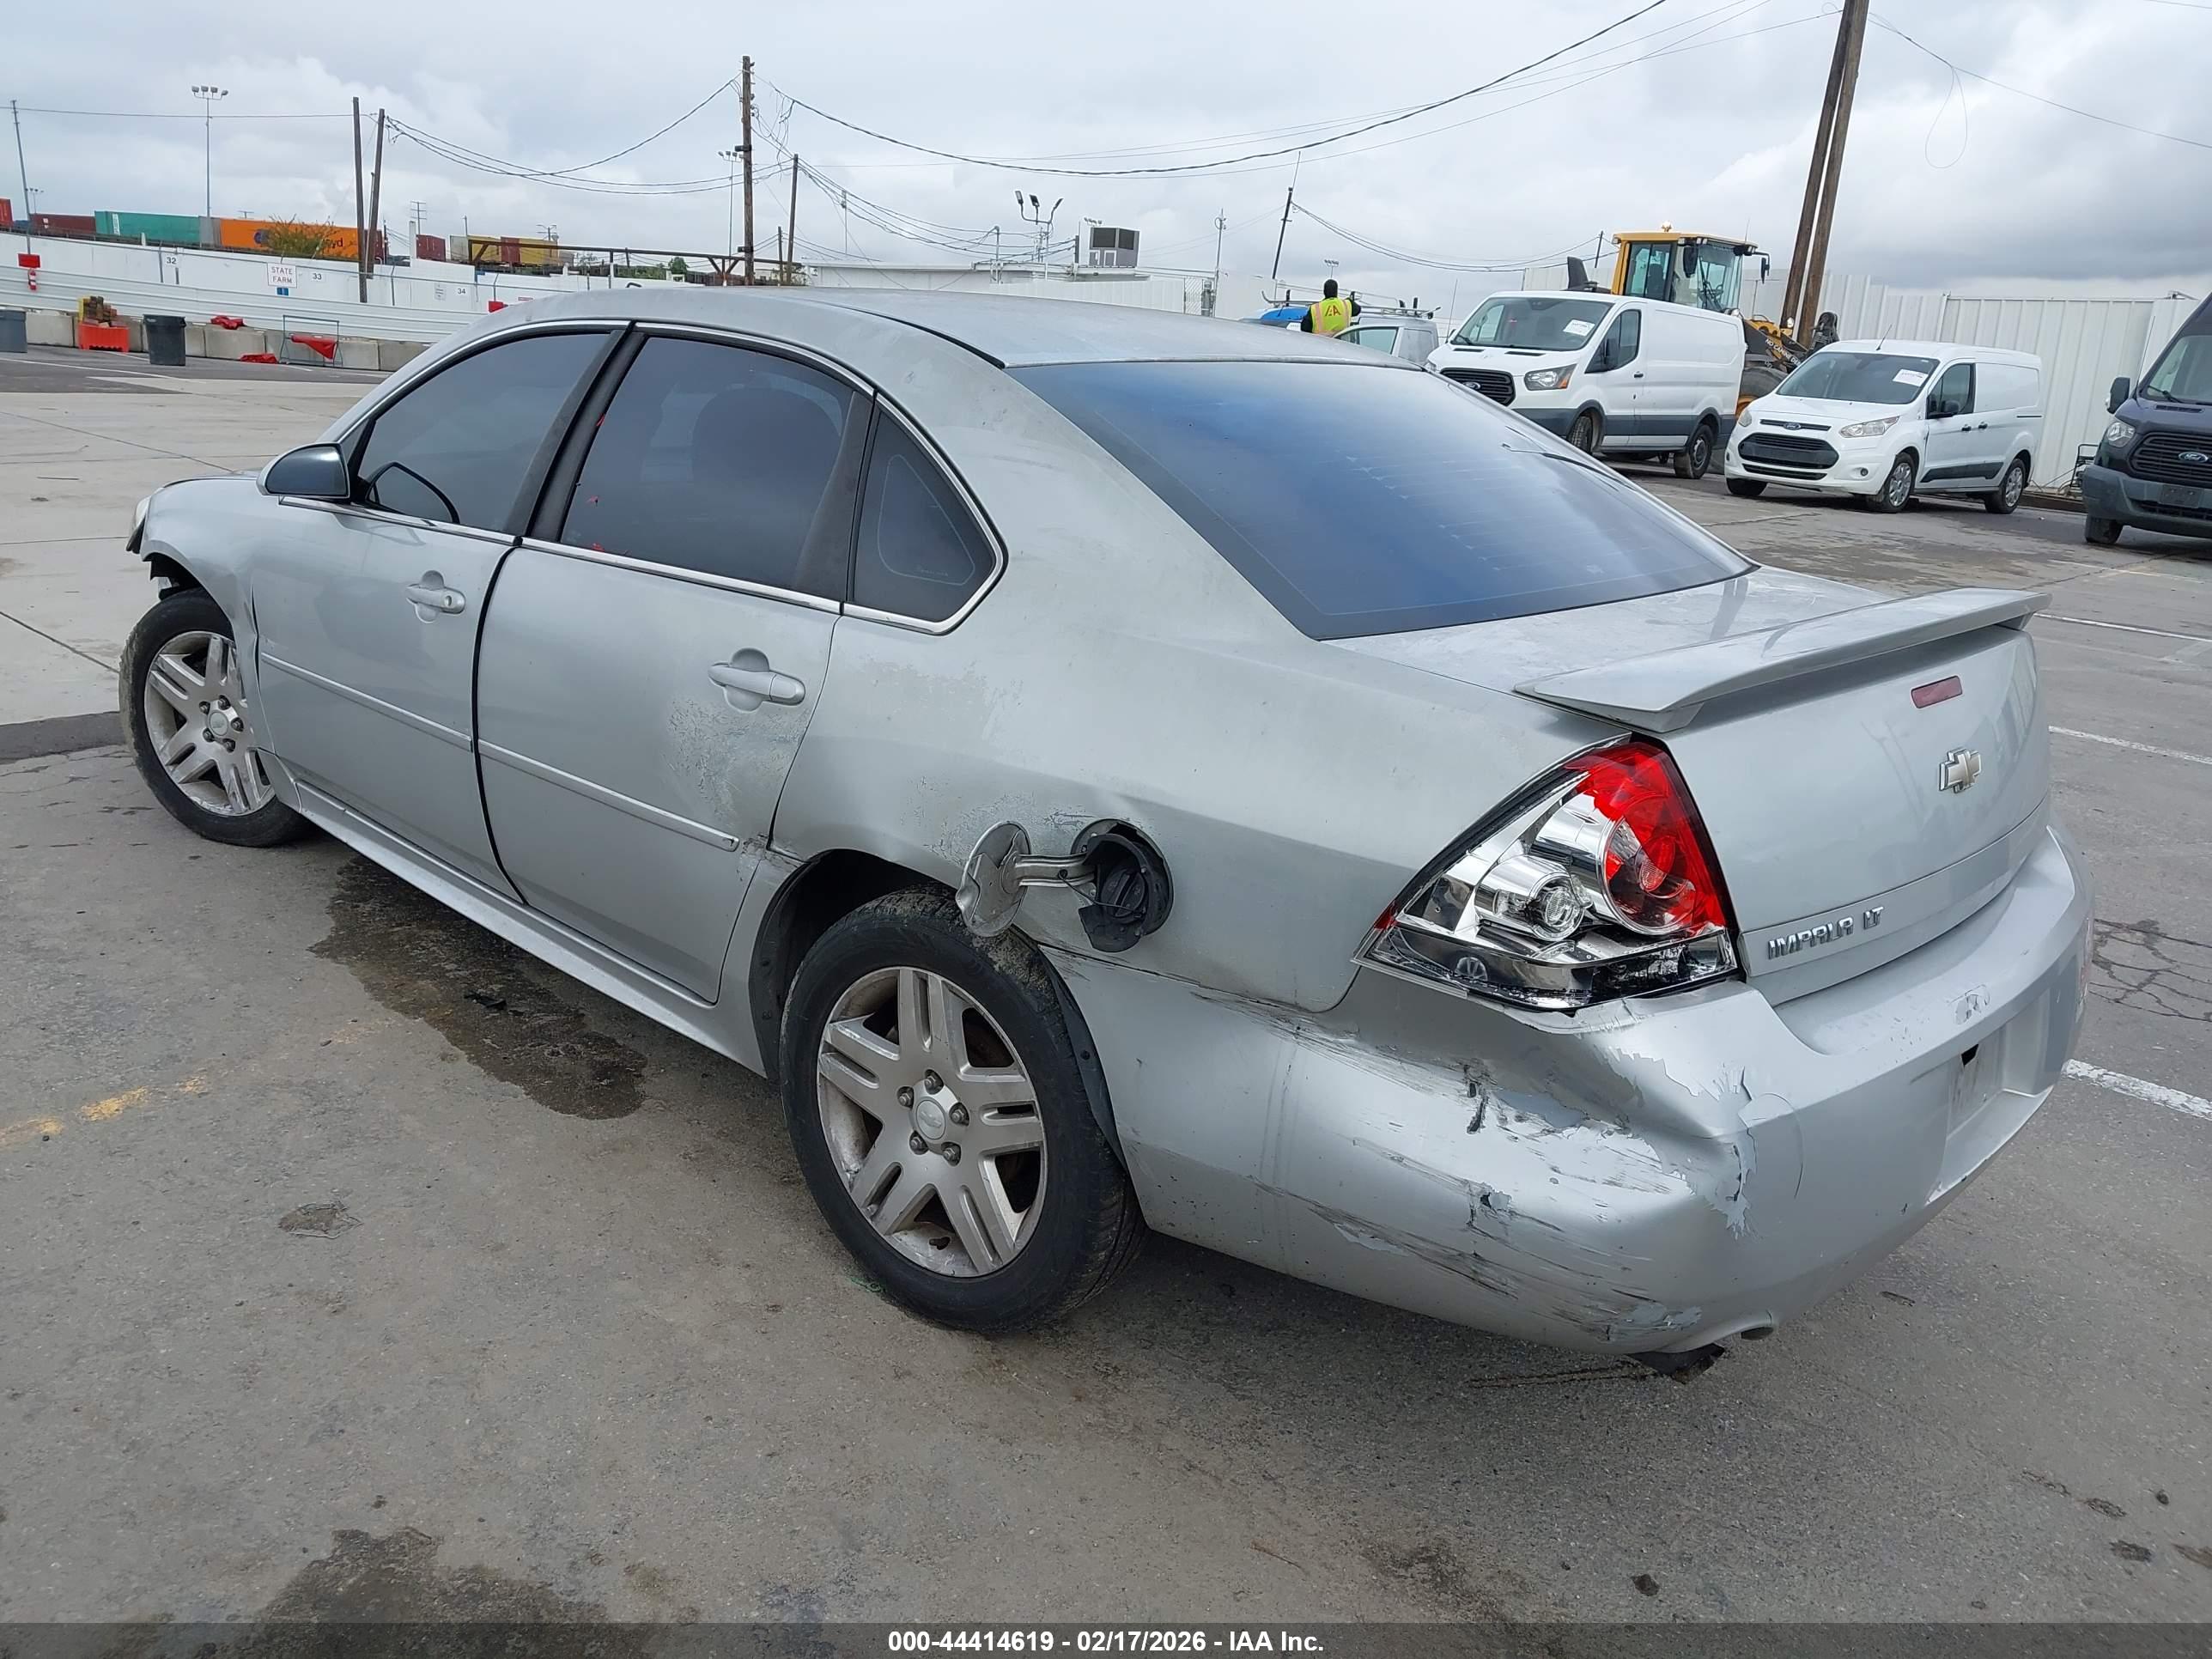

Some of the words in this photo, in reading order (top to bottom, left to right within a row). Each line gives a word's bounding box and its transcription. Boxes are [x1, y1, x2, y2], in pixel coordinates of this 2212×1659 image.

[271, 266, 293, 275] STATE
[272, 276, 293, 284] FARM
[1765, 337, 1774, 347] NO
[1767, 916, 1854, 960] IMPALA
[1863, 906, 1884, 930] LT
